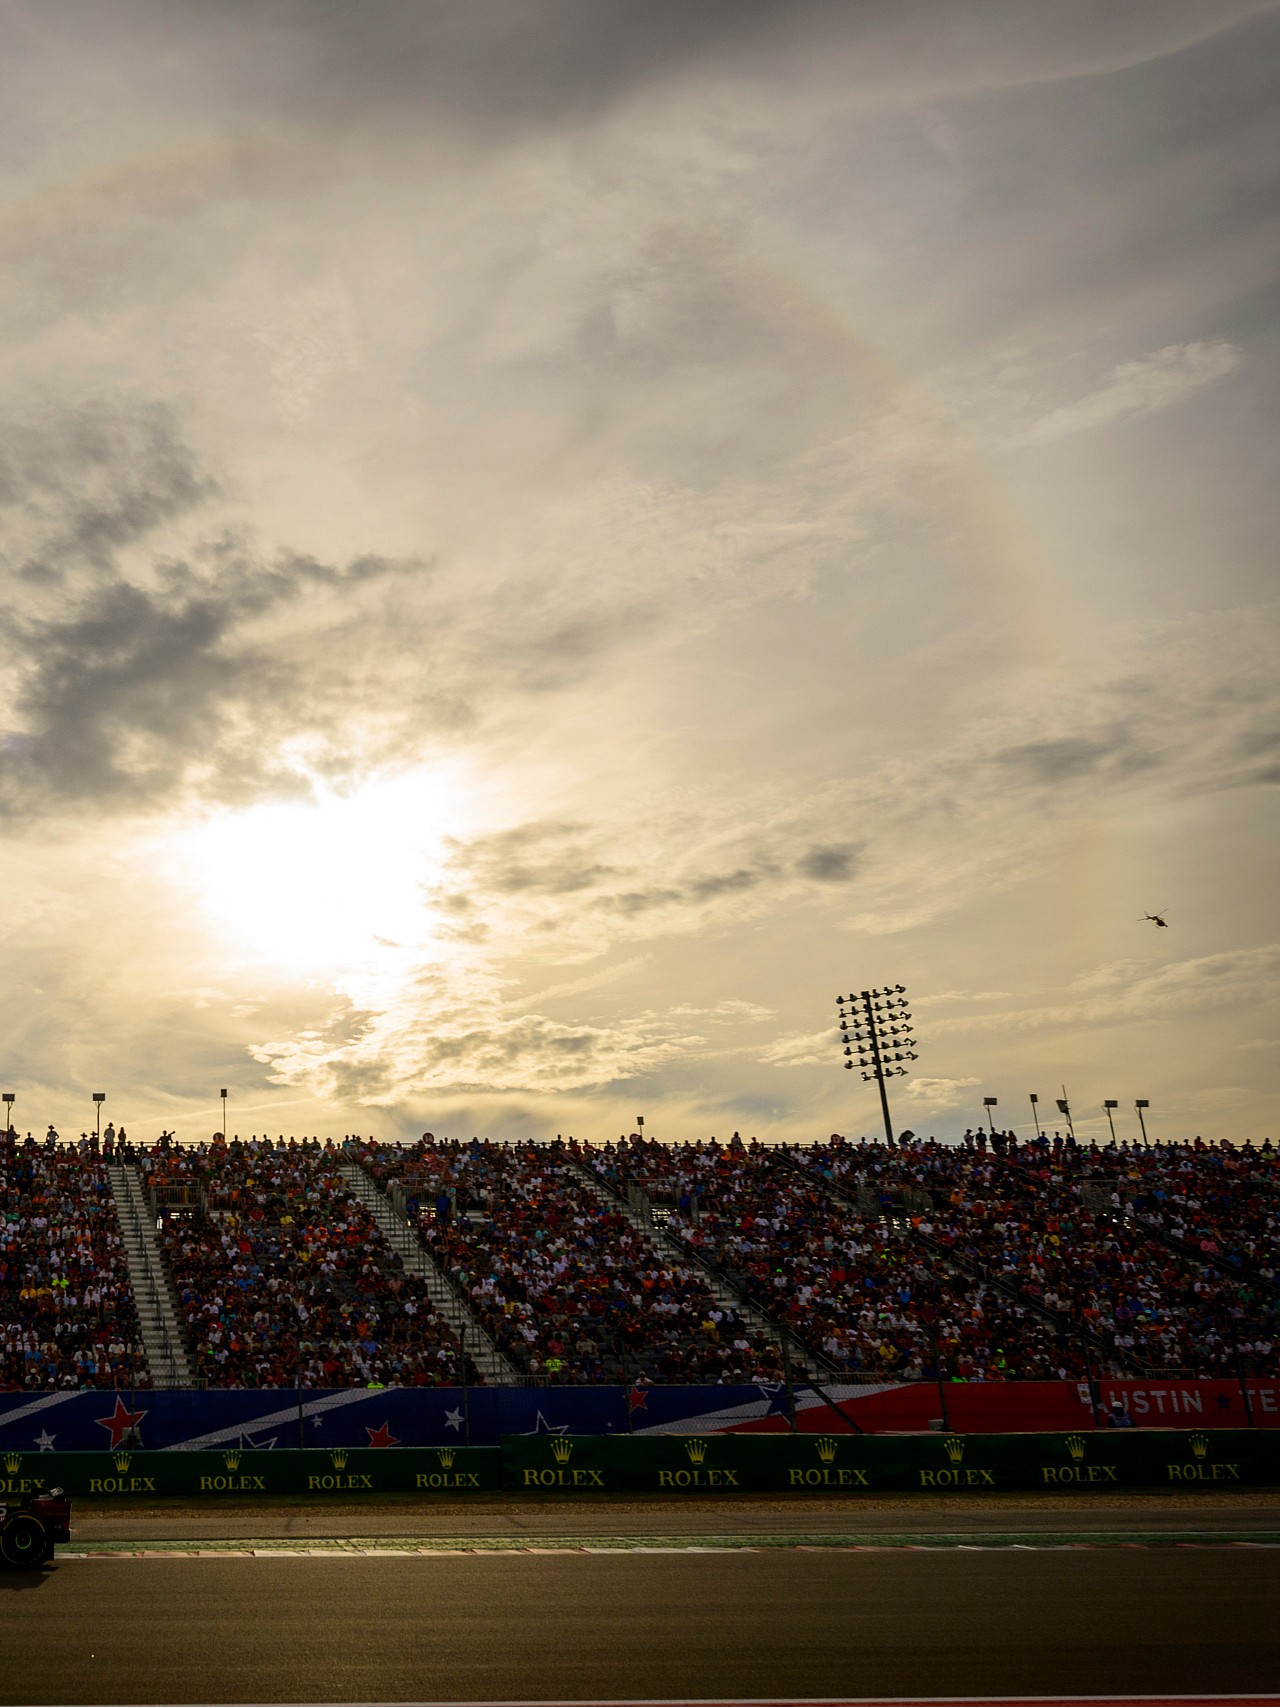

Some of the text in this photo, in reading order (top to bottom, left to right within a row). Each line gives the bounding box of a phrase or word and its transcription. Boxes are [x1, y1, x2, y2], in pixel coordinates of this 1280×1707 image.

[1237, 1389, 1280, 1412] TE
[415, 1472, 481, 1488] ROLEX
[522, 1469, 605, 1486] ROLEX
[658, 1469, 738, 1487] ROLEX
[788, 1468, 870, 1486] ROLEX
[919, 1469, 995, 1486] ROLEX
[1040, 1465, 1118, 1483] ROLEX
[1167, 1463, 1238, 1480] ROLEX
[89, 1477, 158, 1493] ROLEX
[200, 1475, 267, 1490] ROLEX
[308, 1474, 374, 1489] ROLEX
